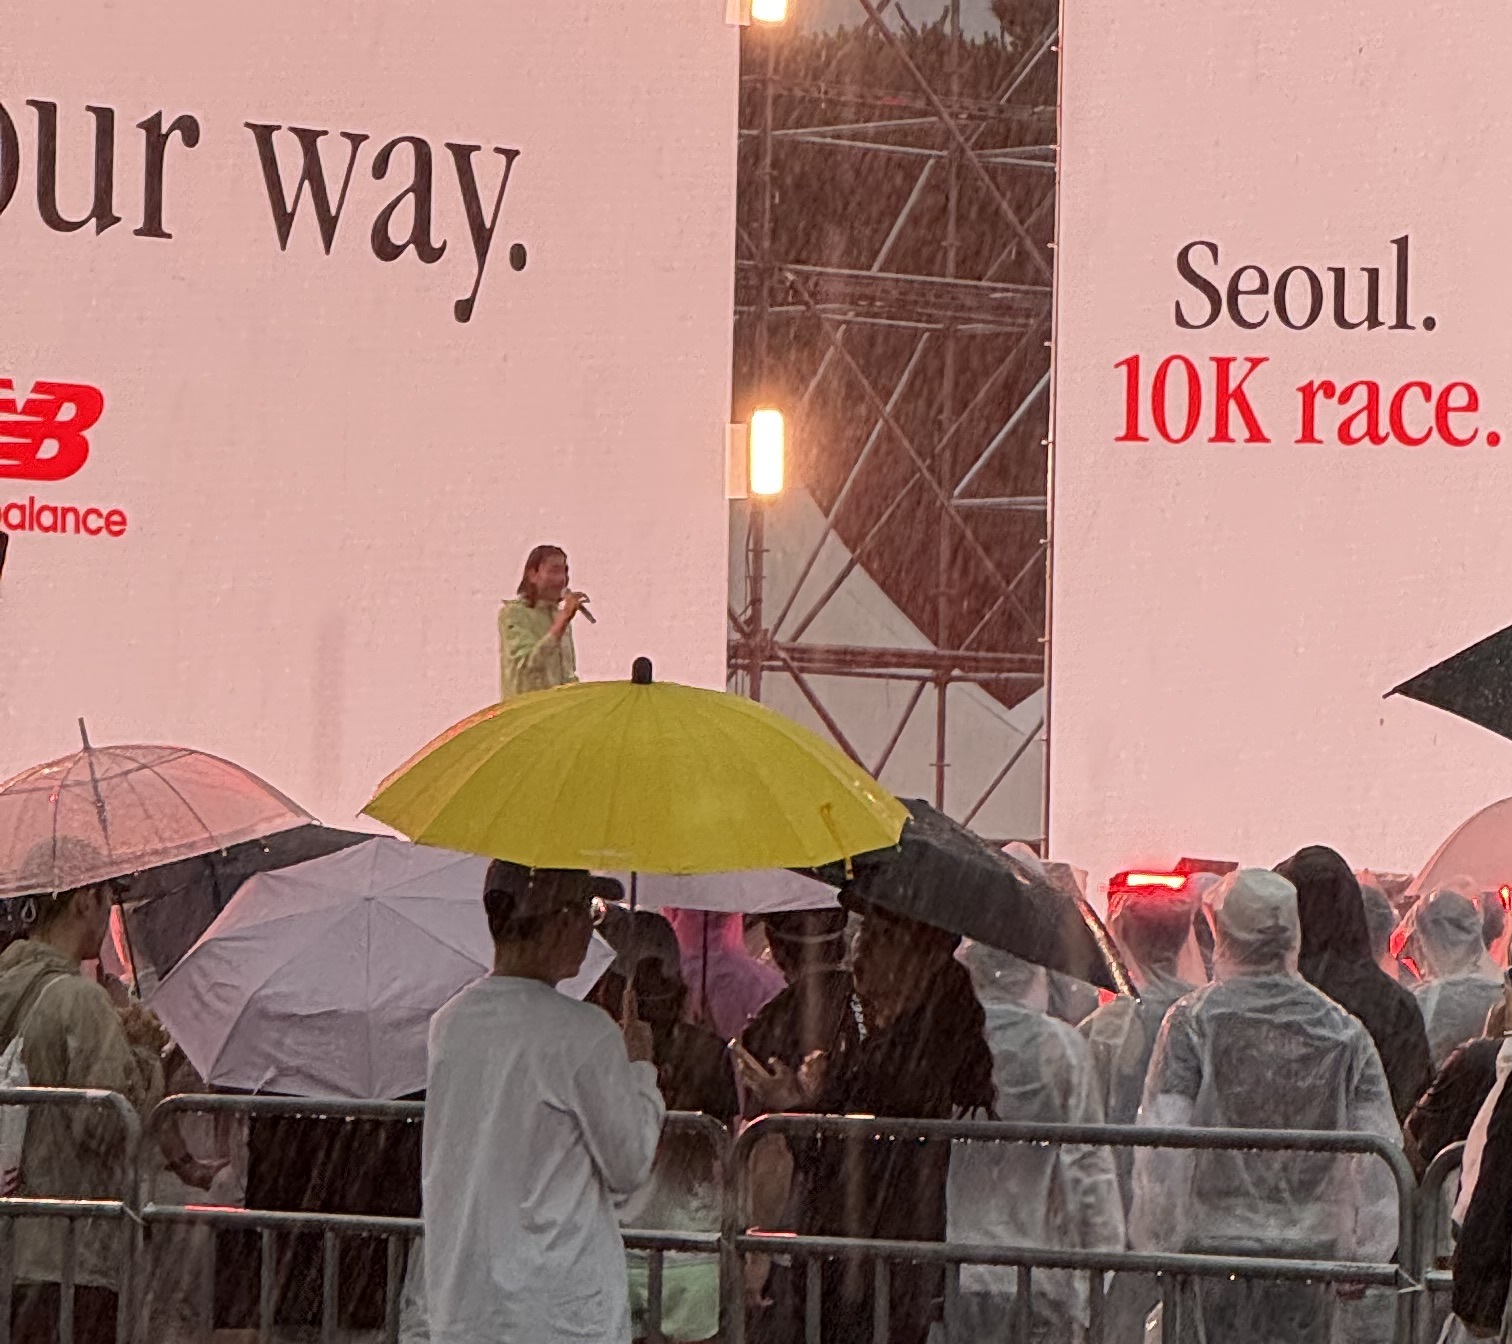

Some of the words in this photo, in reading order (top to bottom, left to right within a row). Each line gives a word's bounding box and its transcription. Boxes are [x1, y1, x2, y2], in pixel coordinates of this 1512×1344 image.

[0, 98, 200, 240] ur
[243, 121, 528, 324] way.
[1174, 234, 1437, 332] Seoul.
[1116, 354, 1270, 444] 10K
[1296, 379, 1501, 448] race.
[0, 495, 128, 538] alance
